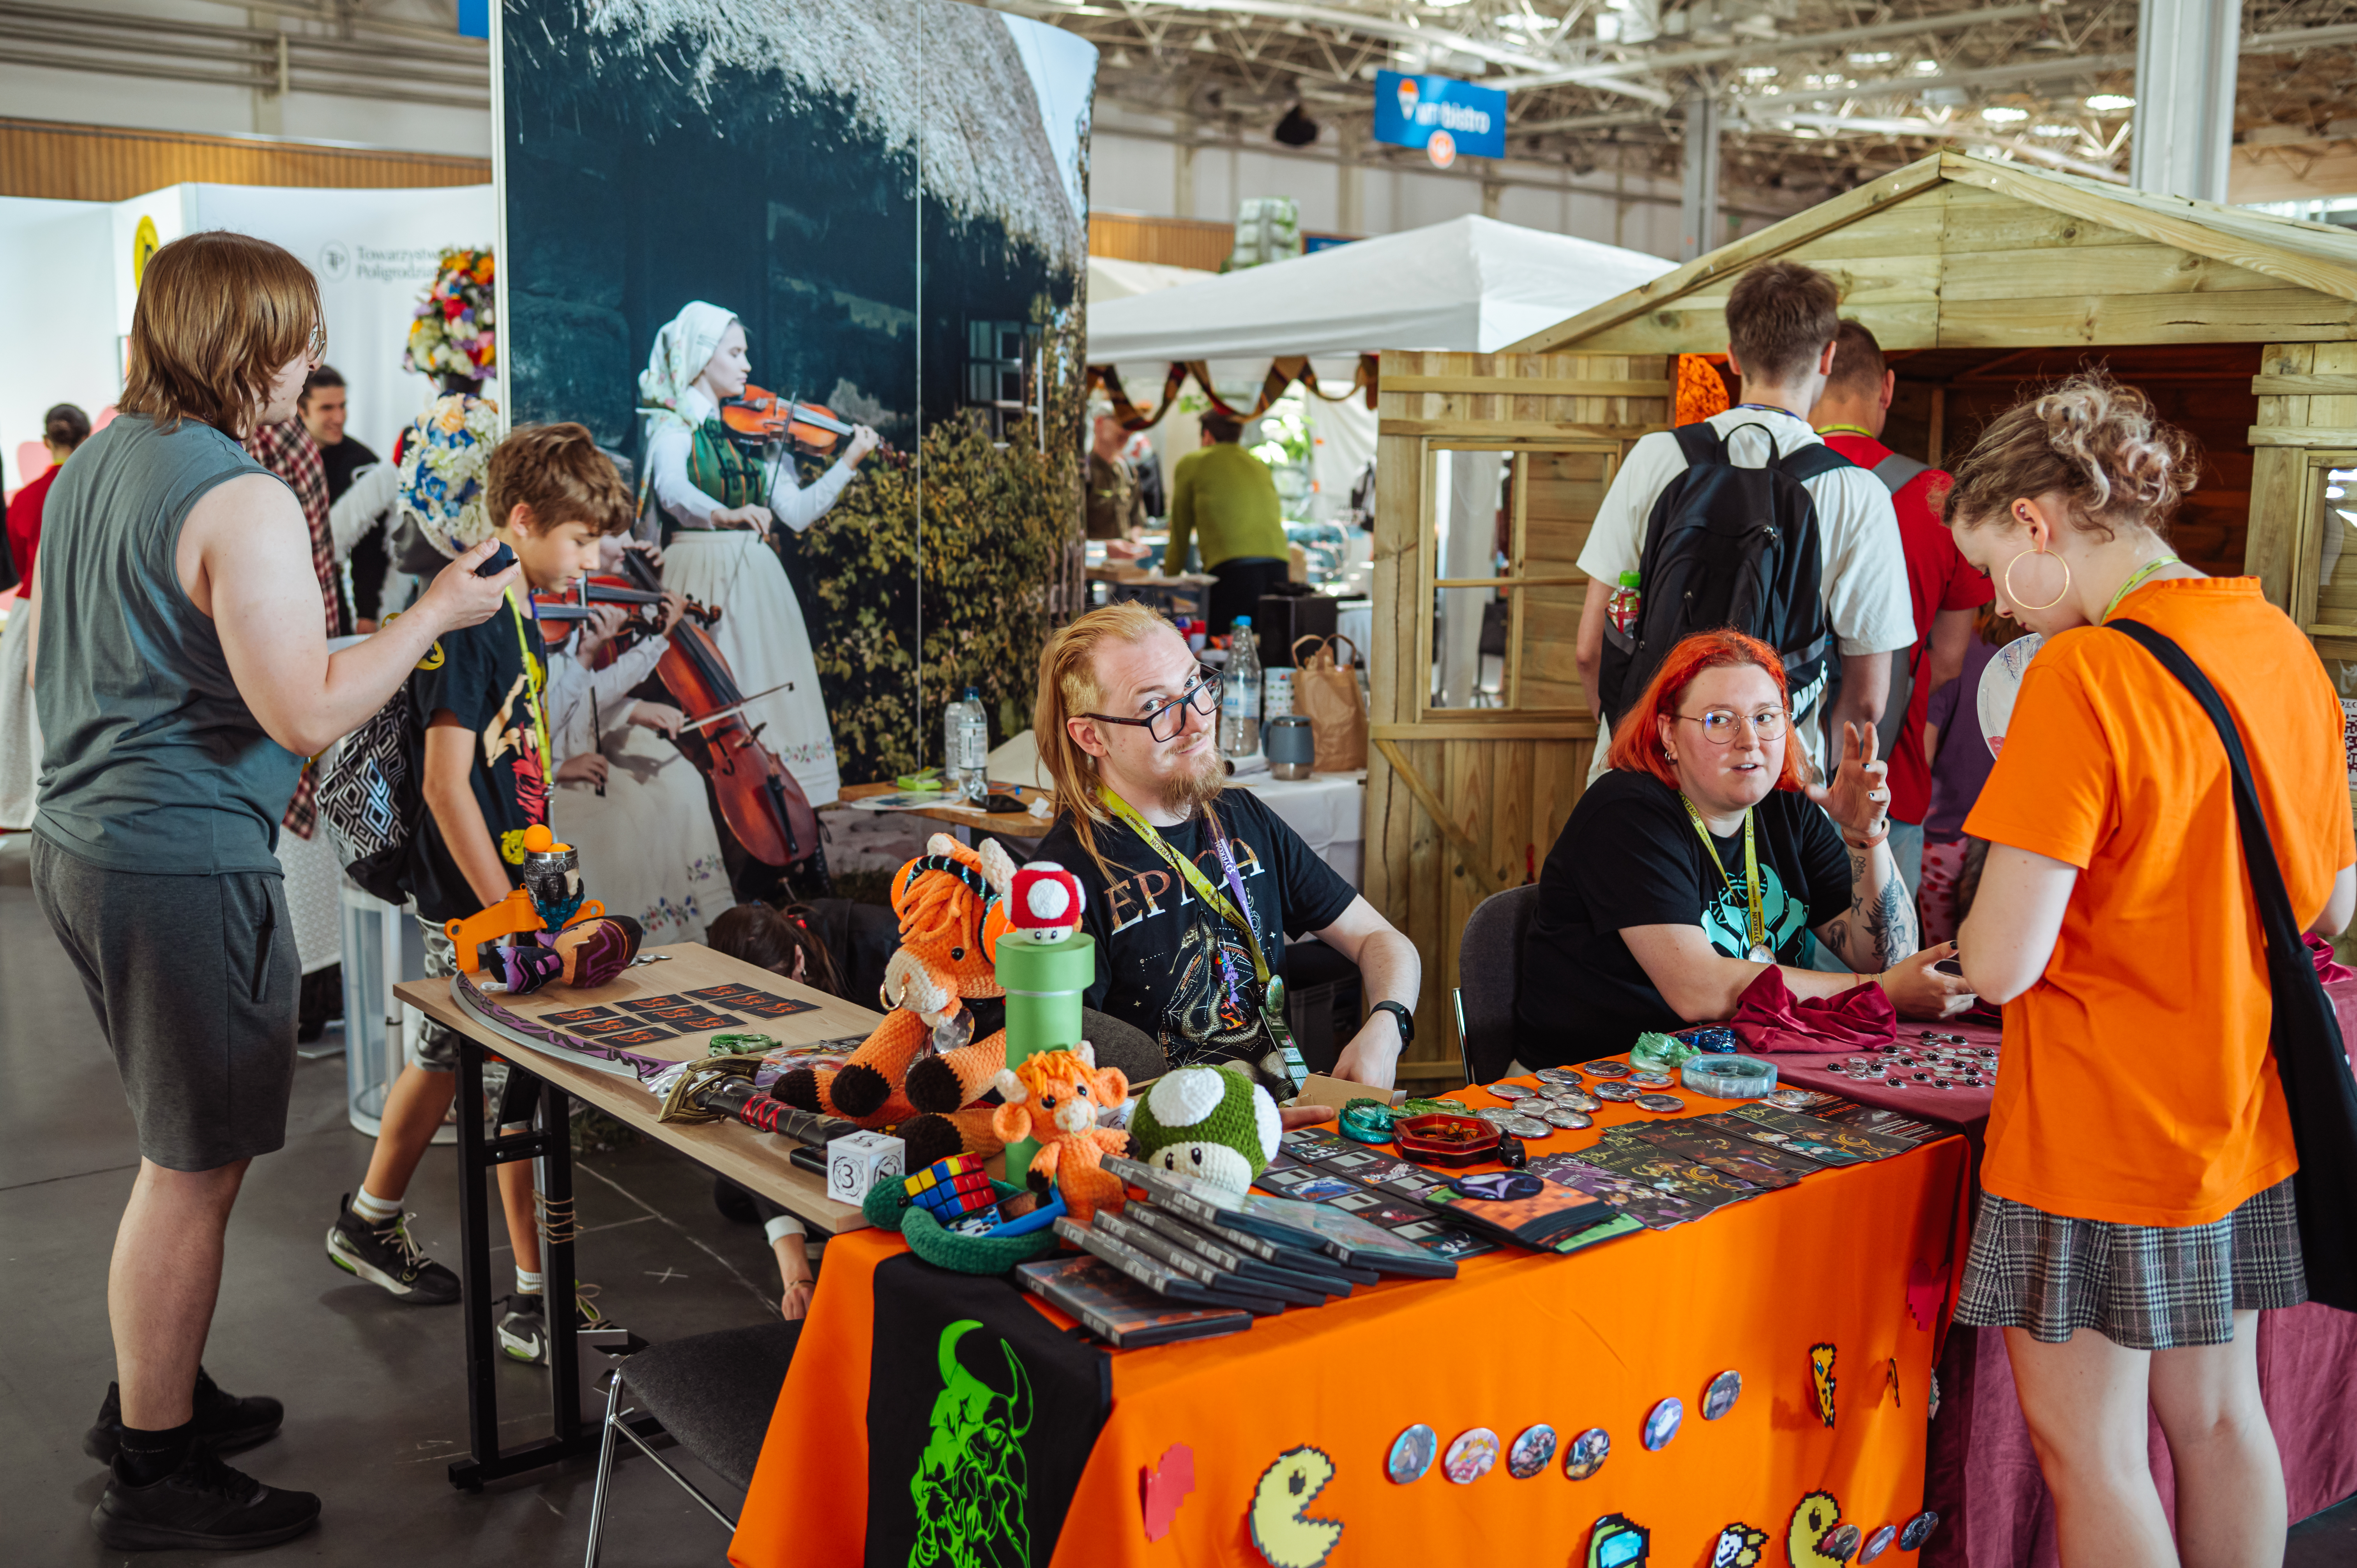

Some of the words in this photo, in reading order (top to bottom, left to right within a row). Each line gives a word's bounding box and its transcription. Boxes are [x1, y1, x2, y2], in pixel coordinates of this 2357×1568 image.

[1126, 812, 1150, 837] WWW.PYRKON.PL
[1150, 838, 1181, 863] PYRKON
[1214, 841, 1237, 874] PYRKON
[1751, 911, 1763, 945] PYRKON
[1179, 969, 1193, 991] spiritus
[842, 1164, 854, 1188] 3
